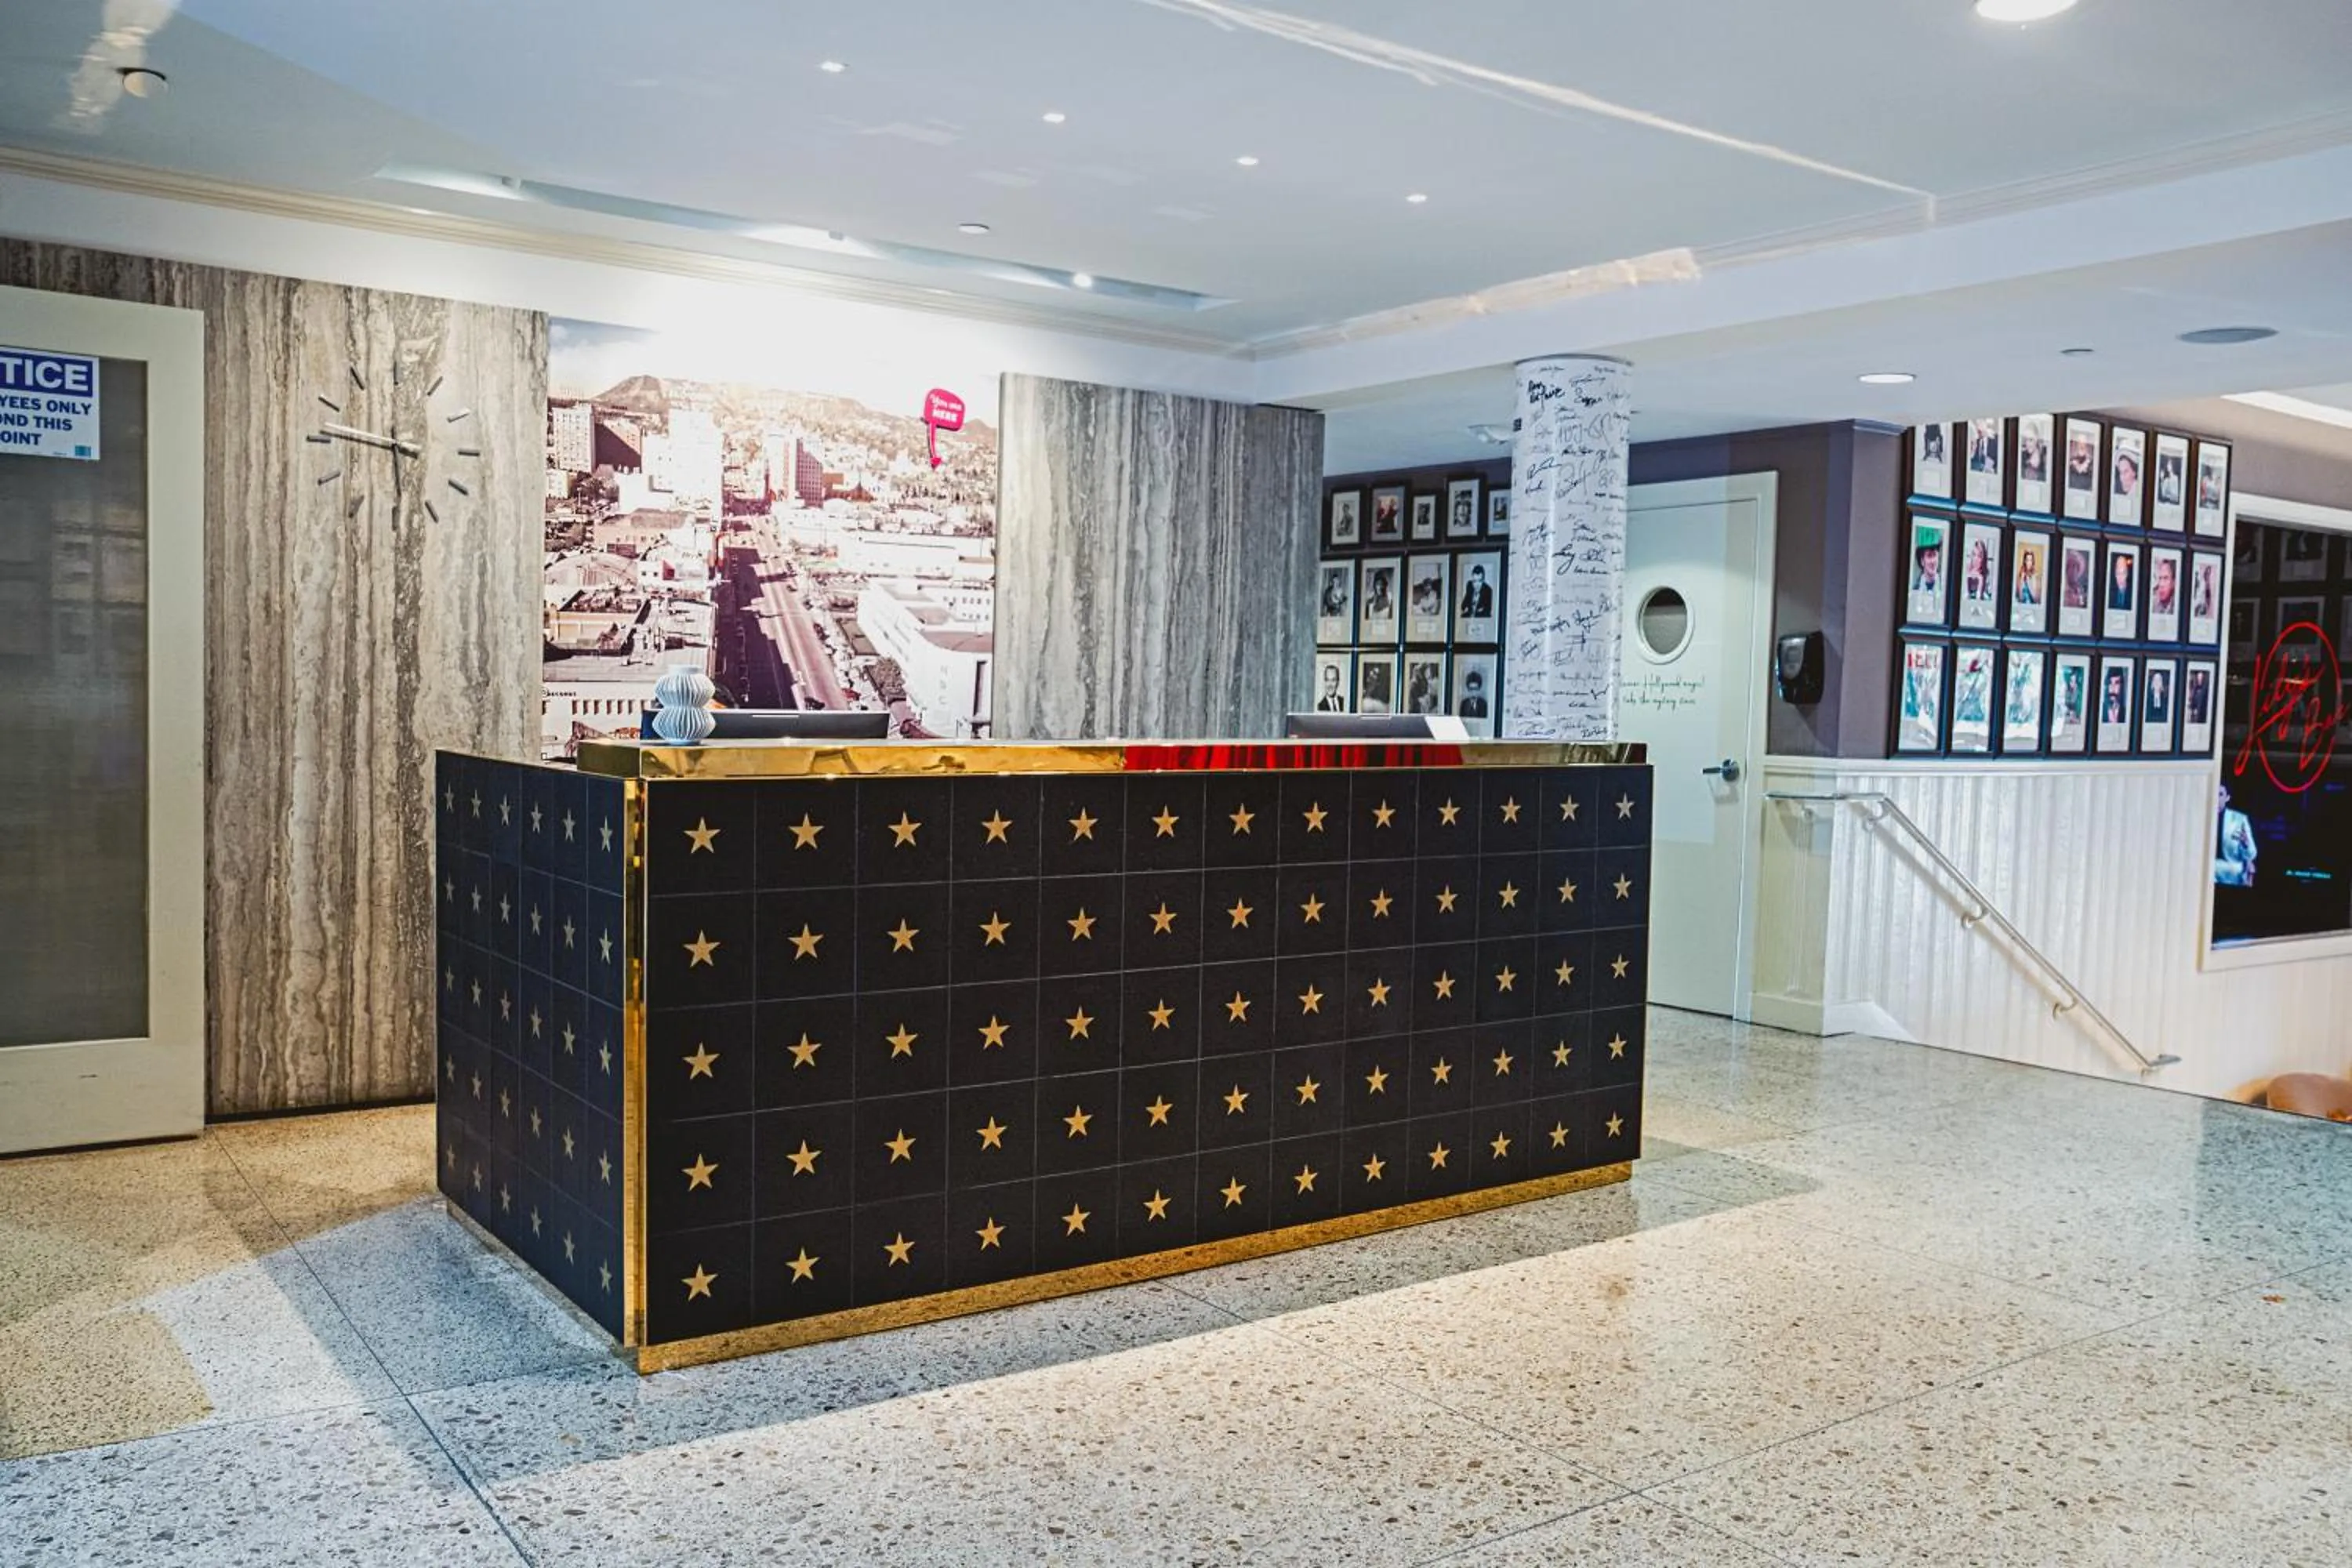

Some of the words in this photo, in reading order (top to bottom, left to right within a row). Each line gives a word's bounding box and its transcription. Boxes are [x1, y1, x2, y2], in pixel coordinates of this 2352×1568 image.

[0, 358, 89, 390] TICE
[46, 400, 92, 415] ONLY
[0, 413, 28, 426] ND
[33, 416, 73, 430] THIS
[0, 430, 42, 445] OINT
